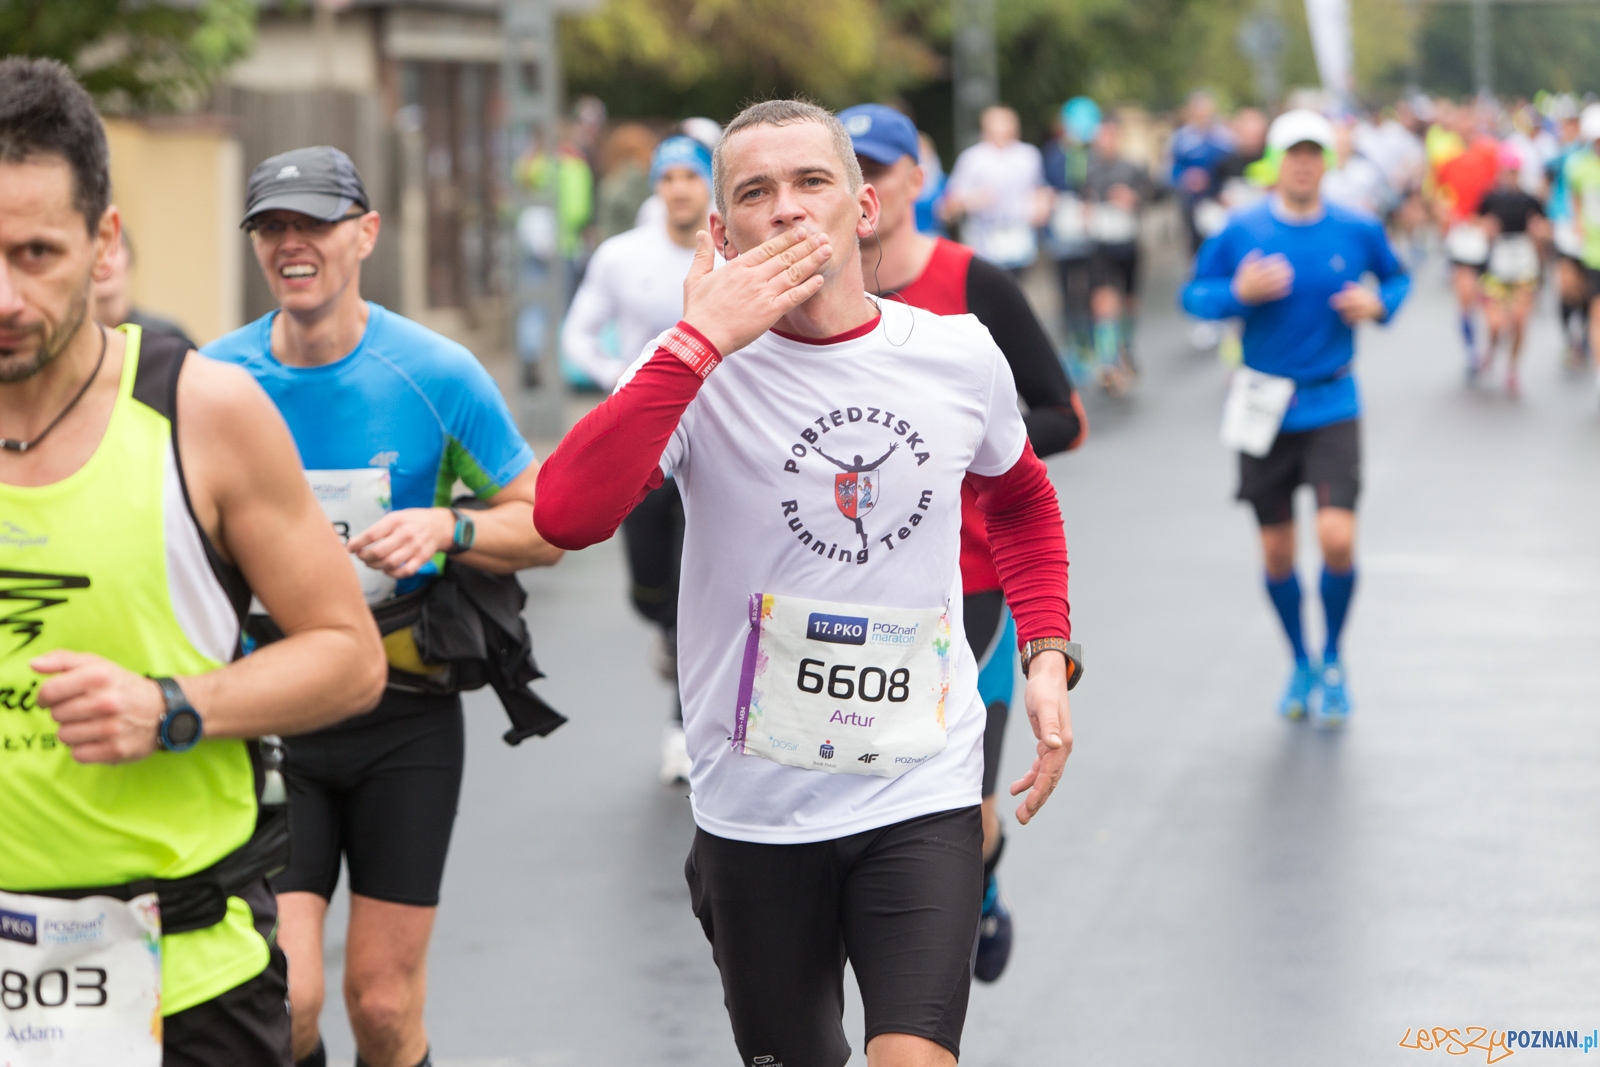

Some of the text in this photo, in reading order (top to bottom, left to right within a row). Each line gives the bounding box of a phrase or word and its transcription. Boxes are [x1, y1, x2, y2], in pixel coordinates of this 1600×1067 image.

[701, 358, 718, 378] START
[783, 406, 931, 474] POBIEDZISKA
[781, 489, 933, 565] Running Team
[871, 633, 915, 644] maraton
[797, 658, 910, 703] 6608
[829, 709, 876, 728] Artur
[857, 753, 880, 764] 4F
[1, 967, 108, 1010] 803
[5, 1023, 64, 1042] Adam
